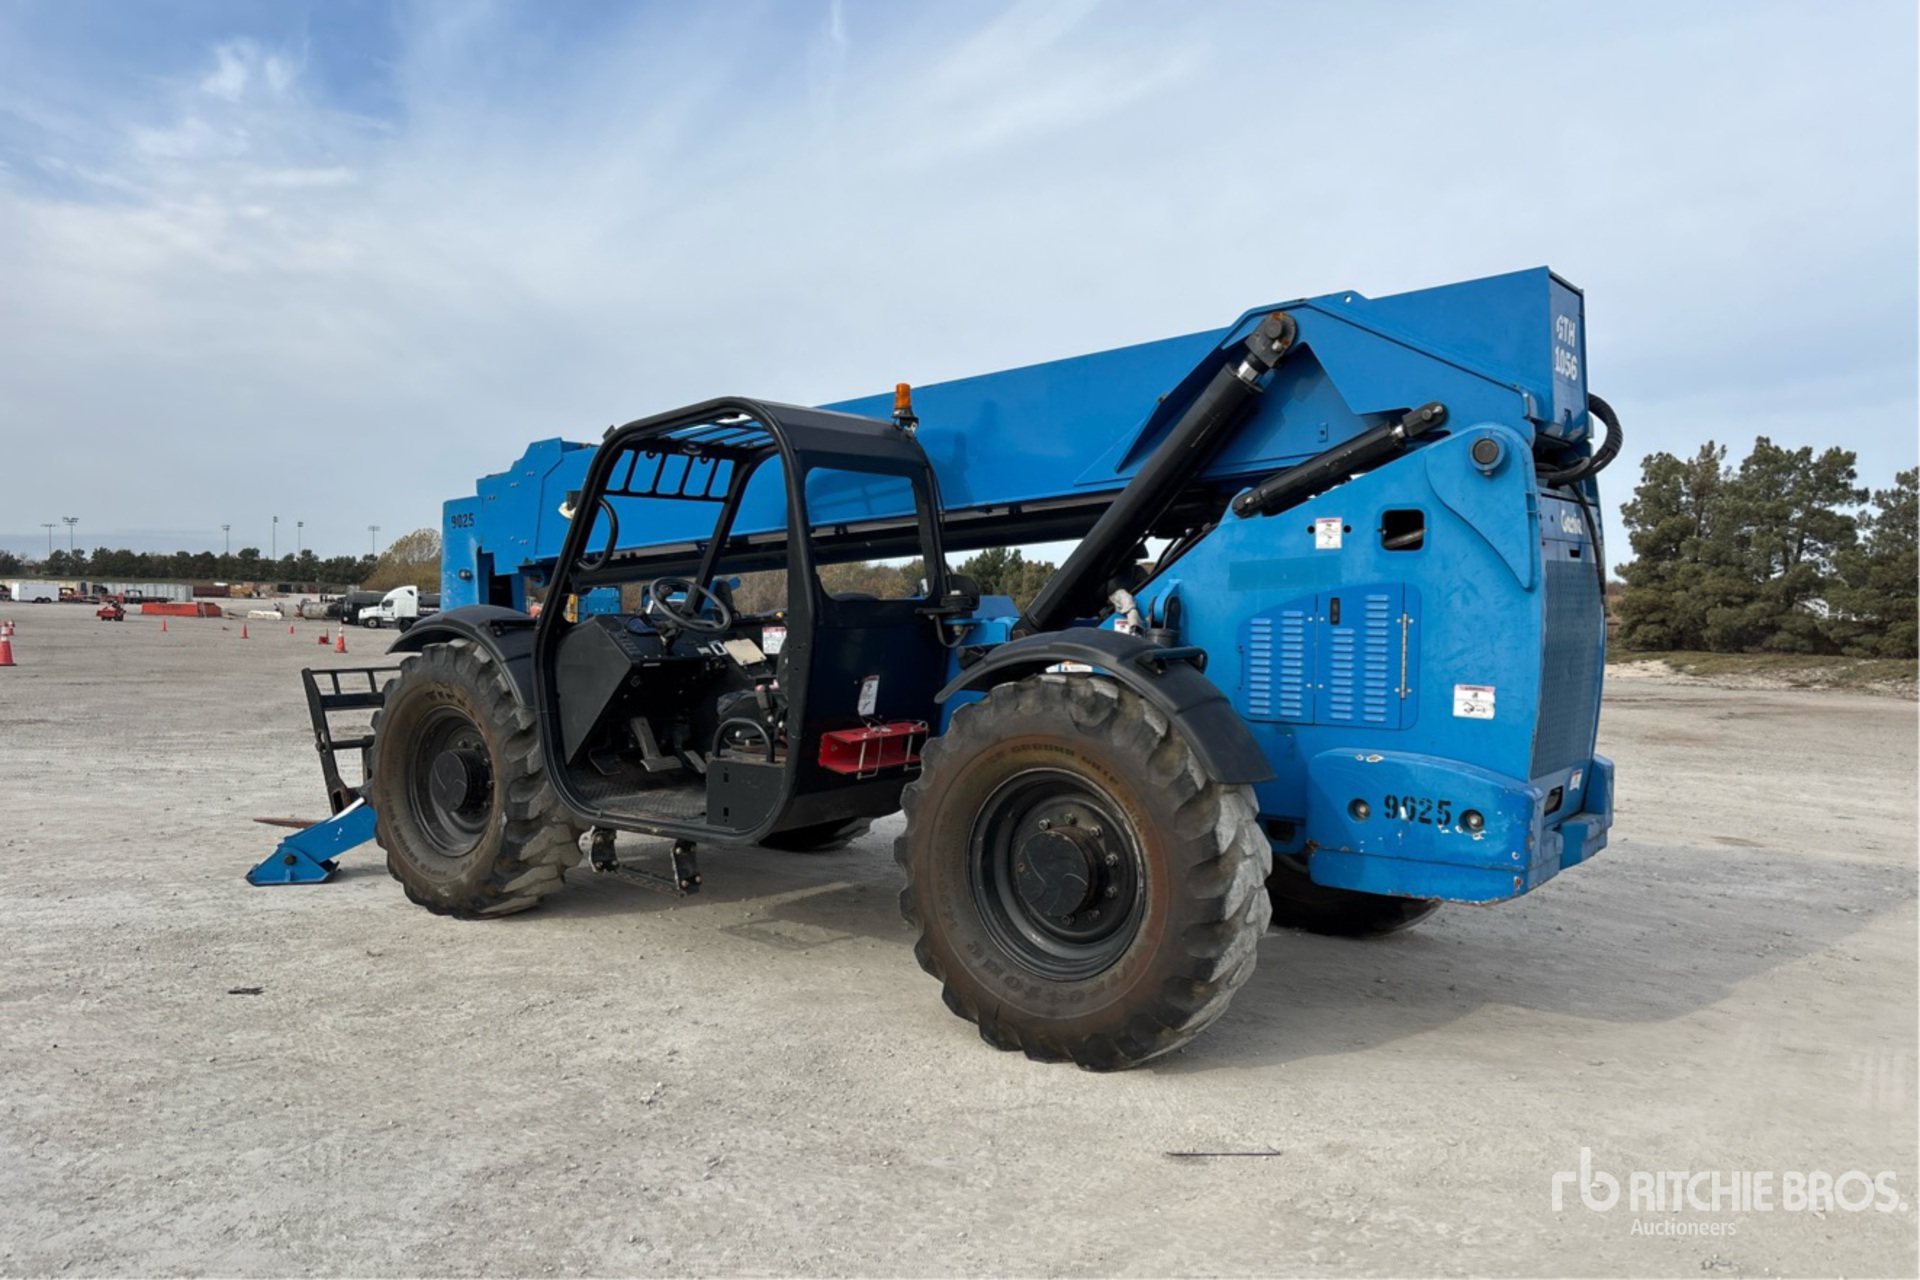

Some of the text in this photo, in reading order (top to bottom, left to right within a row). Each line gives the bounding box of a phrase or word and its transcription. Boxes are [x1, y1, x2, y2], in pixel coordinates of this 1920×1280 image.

[1556, 314, 1576, 347] GTH
[1555, 346, 1578, 381] 1056
[450, 512, 475, 529] 9025
[1384, 794, 1452, 826] 9025
